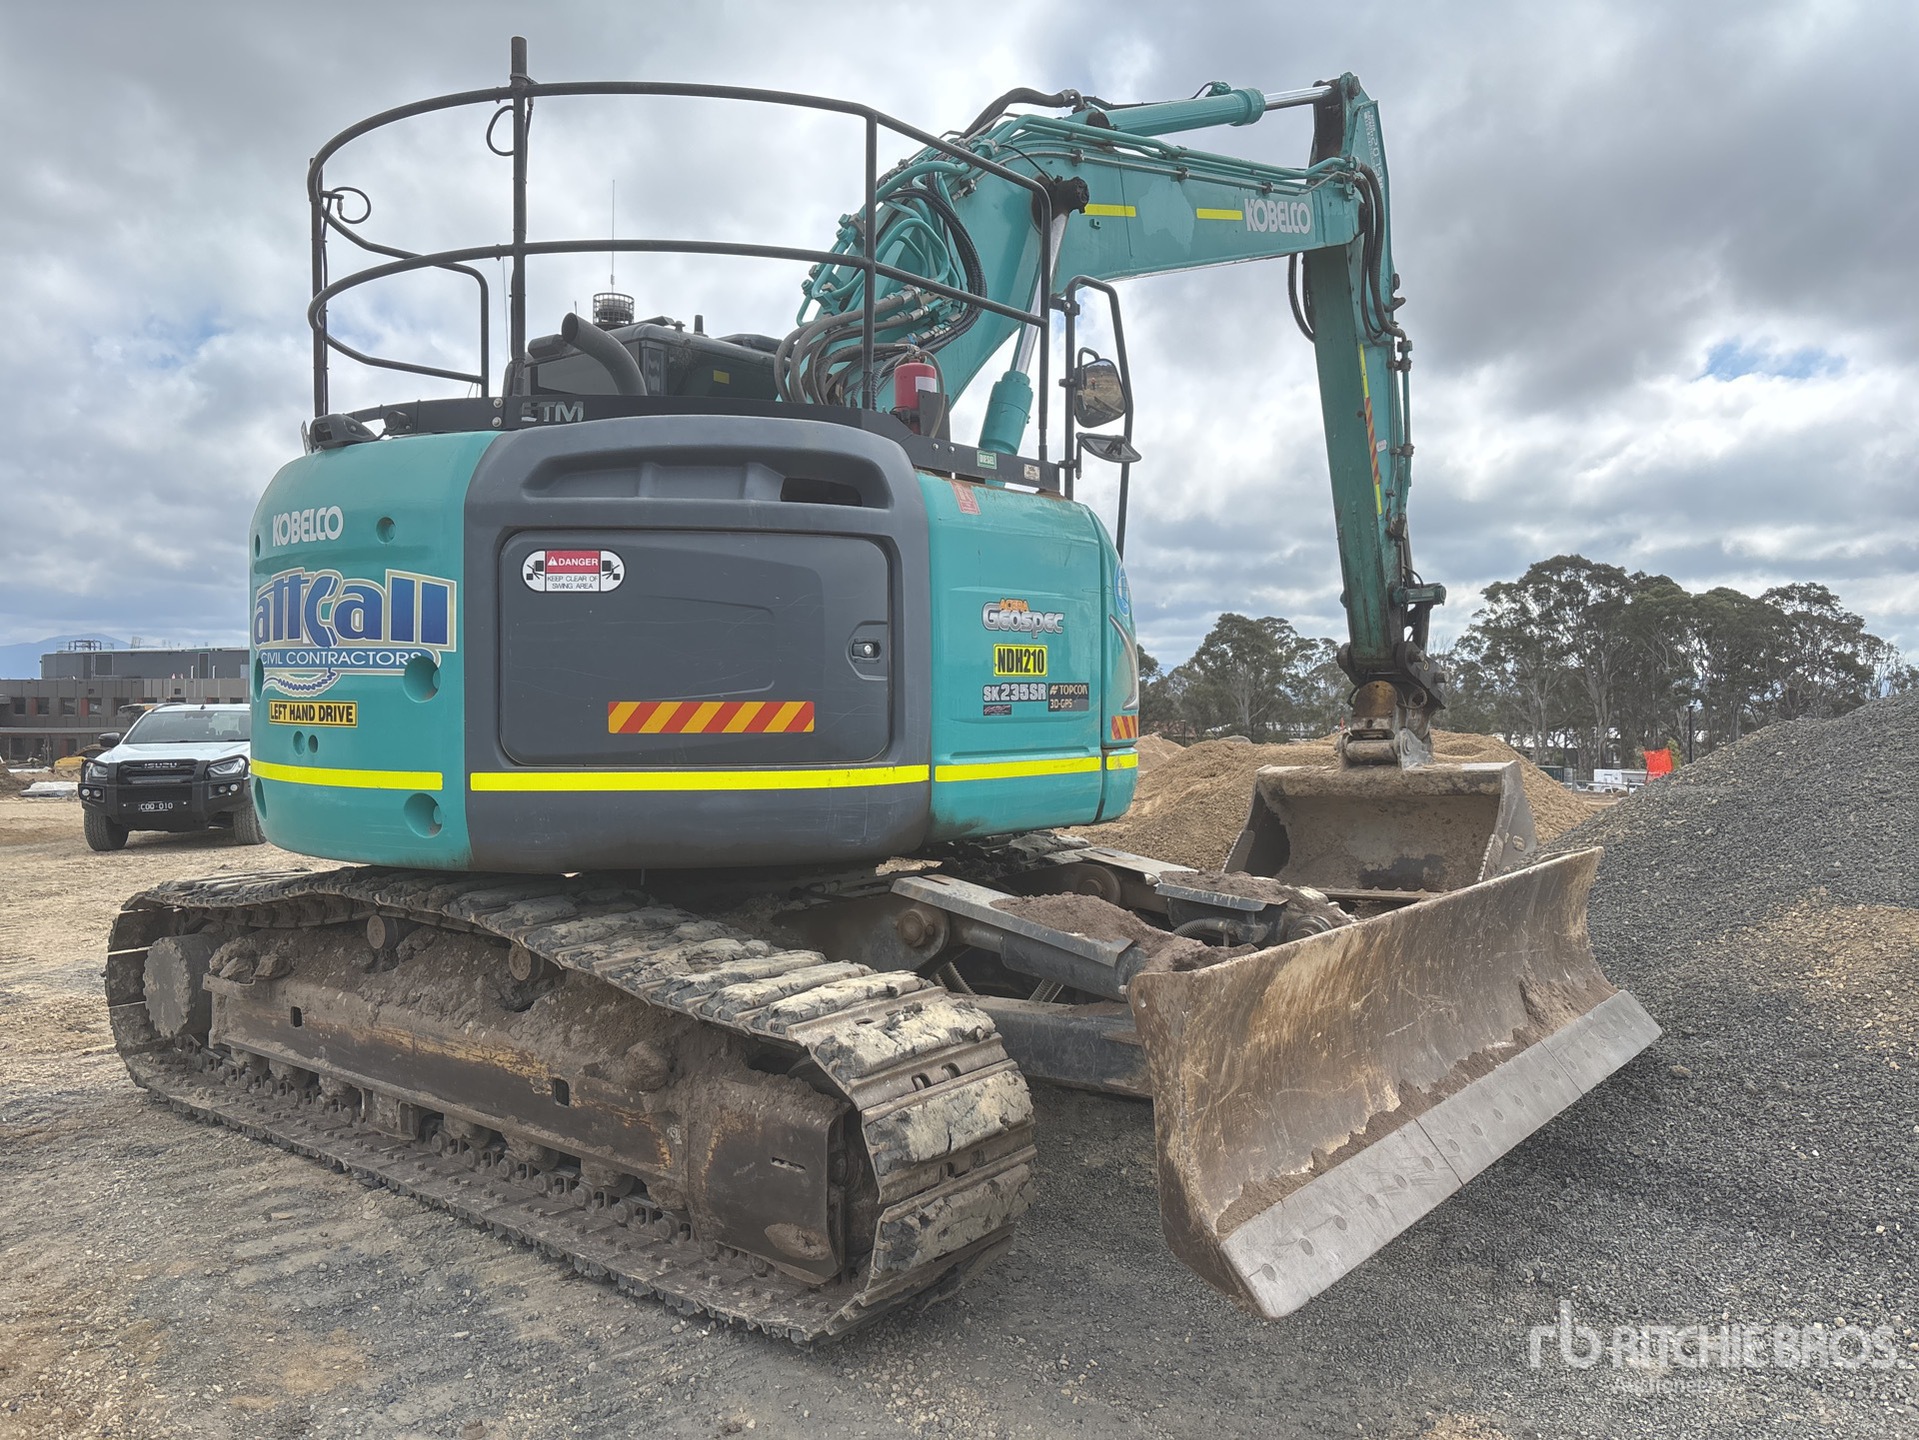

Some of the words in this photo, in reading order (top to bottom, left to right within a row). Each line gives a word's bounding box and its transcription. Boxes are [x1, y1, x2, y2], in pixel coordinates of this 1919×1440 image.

[1244, 198, 1312, 235] KOBELCO
[272, 505, 344, 547] KOBELCO
[558, 558, 599, 566] DANGER
[551, 582, 573, 590] SWING
[575, 582, 594, 590] AREA
[261, 652, 283, 665] CIVIL
[997, 648, 1045, 674] NDH210
[983, 683, 1047, 702] SK235SR
[1060, 685, 1088, 695] TOPCON
[1050, 699, 1073, 709] 3D-GPS
[270, 703, 287, 720] LEFT
[289, 704, 315, 721] HAND
[318, 705, 353, 723] DRIVE
